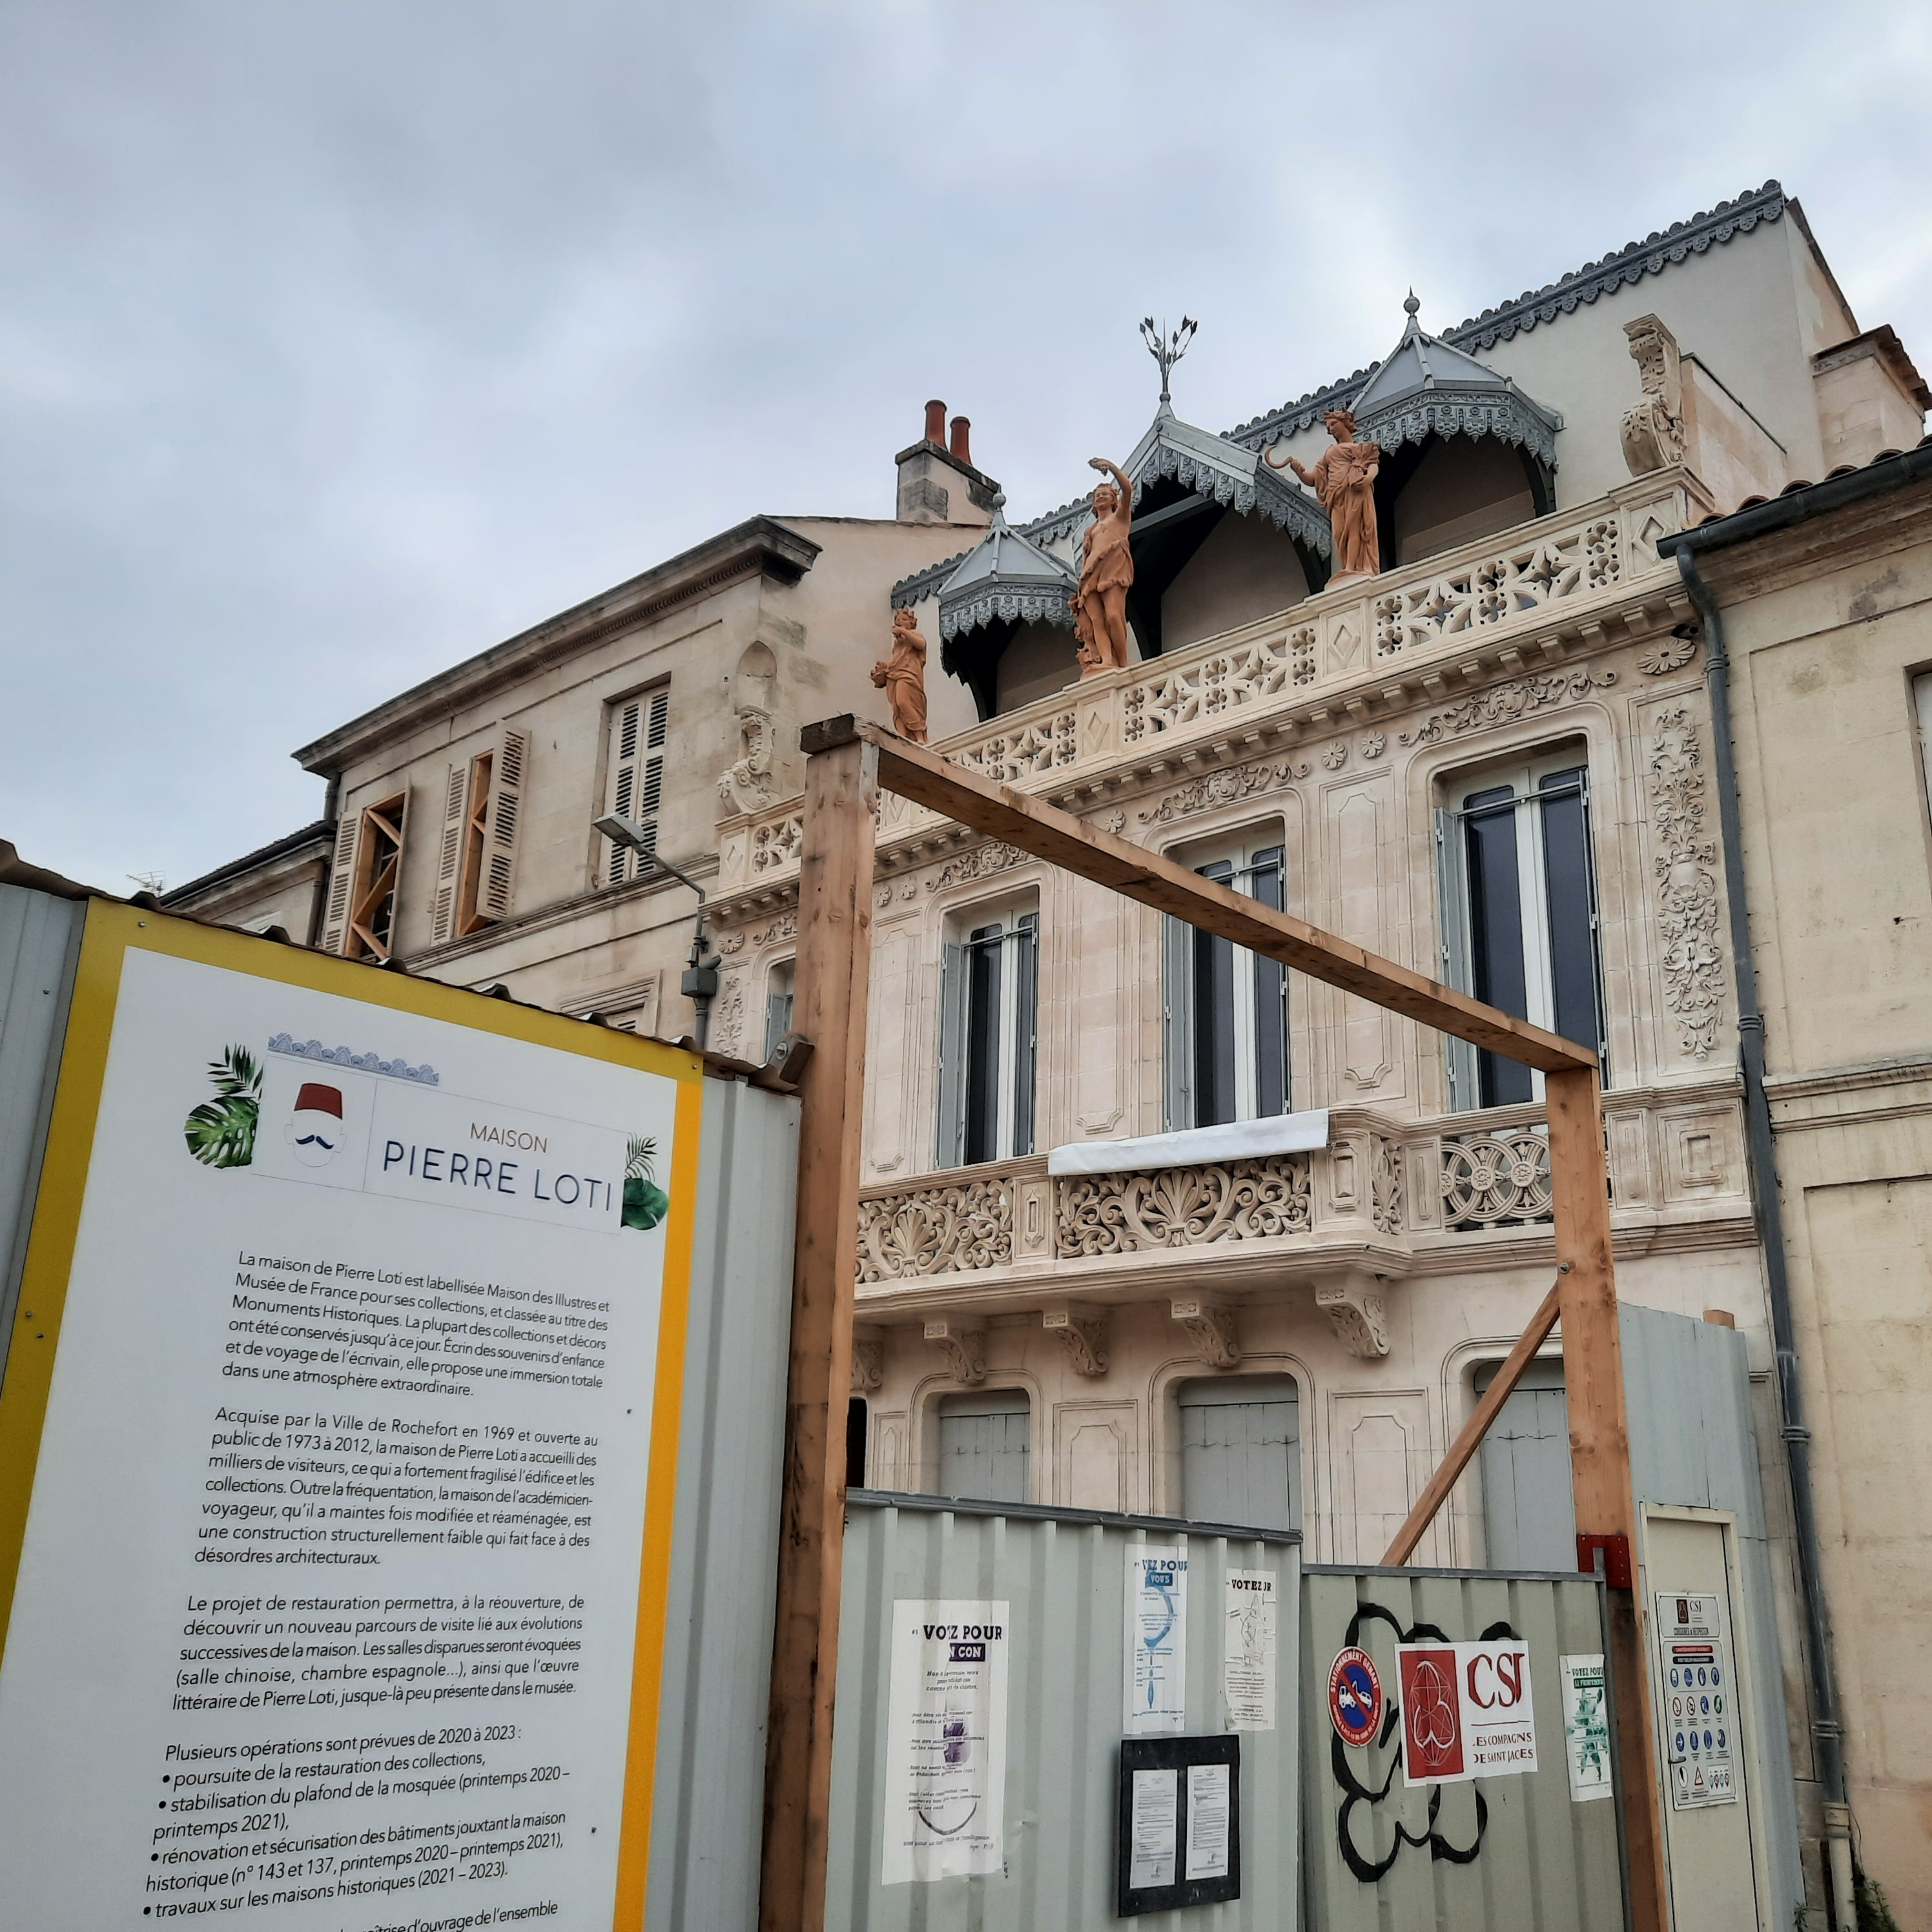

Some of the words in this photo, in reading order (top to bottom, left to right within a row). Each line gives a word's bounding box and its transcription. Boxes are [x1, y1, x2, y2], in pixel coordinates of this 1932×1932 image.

[470, 1122, 548, 1153] MAISON
[384, 1140, 519, 1194] PIERRE
[534, 1169, 611, 1211] LOTI
[239, 1250, 255, 1266] La
[259, 1256, 310, 1273] maison
[314, 1260, 332, 1276] de
[335, 1262, 375, 1281] Pierre
[378, 1268, 402, 1284] Loti
[405, 1275, 424, 1288] est
[427, 1273, 484, 1295] labellisée
[487, 1283, 529, 1301] Maison
[533, 1289, 553, 1304] des
[555, 1292, 597, 1310] Illustres
[598, 1301, 610, 1312] et
[236, 1271, 285, 1291] Musée
[289, 1278, 307, 1294] de
[311, 1280, 357, 1300] France
[360, 1291, 394, 1306] pour
[395, 1295, 415, 1307] ses
[418, 1295, 488, 1318] collections,
[490, 1306, 502, 1318] et
[504, 1305, 546, 1323] classée
[548, 1315, 562, 1325] au
[564, 1313, 586, 1328] titre
[588, 1316, 608, 1331] des
[232, 1293, 320, 1317] Monuments
[323, 1304, 402, 1328] Historiques.
[406, 1313, 421, 1328] La
[422, 1316, 468, 1336] plupart
[469, 1321, 491, 1337] des
[493, 1324, 555, 1344] collections
[557, 1334, 568, 1346] et
[570, 1333, 606, 1350] décors
[222, 1360, 258, 1378] dans
[262, 1368, 289, 1381] une
[293, 1370, 377, 1390] atmosphère
[380, 1378, 474, 1396] extraordinaire.
[225, 1341, 241, 1354] et
[243, 1339, 263, 1356] de
[266, 1346, 318, 1364] voyage
[321, 1347, 340, 1363] de
[406, 1355, 429, 1372] elle
[431, 1362, 483, 1379] propose
[485, 1367, 508, 1379] une
[509, 1366, 570, 1384] immersion
[571, 1374, 603, 1388] totale
[215, 1406, 279, 1428] Acquise
[284, 1415, 311, 1431] par
[314, 1412, 327, 1428] la
[333, 1414, 364, 1430] Ville
[368, 1416, 387, 1432] de
[391, 1418, 458, 1437] Rochefort
[462, 1427, 478, 1438] en
[484, 1424, 515, 1440] 1969
[518, 1430, 531, 1442] et
[535, 1432, 581, 1445] ouverte
[584, 1436, 598, 1446] au
[202, 1503, 277, 1520] voyageur,
[317, 1506, 325, 1518] a
[329, 1505, 385, 1520] maintes
[389, 1504, 412, 1521] fois
[415, 1506, 473, 1523] modifiée
[477, 1511, 490, 1523] et
[492, 1509, 571, 1529] réaménagée,
[574, 1514, 591, 1526] est
[198, 1527, 228, 1539] une
[232, 1526, 327, 1541] construction
[331, 1527, 444, 1543] structurellement
[447, 1528, 483, 1545] faible
[486, 1531, 506, 1549] qui
[509, 1530, 528, 1545] fait
[531, 1530, 556, 1546] face
[559, 1532, 566, 1546] à
[568, 1532, 590, 1547] des
[194, 1546, 272, 1563] désordres
[276, 1547, 381, 1565] architecturaux.
[1150, 1574, 1171, 1583] VOUS
[1231, 1579, 1262, 1591] VOTEZ
[188, 1594, 207, 1611] Le
[212, 1595, 262, 1616] projet
[266, 1594, 287, 1610] de
[291, 1595, 380, 1610] restauration
[384, 1596, 457, 1614] permettra,
[462, 1594, 469, 1609] à
[474, 1594, 484, 1609] la
[489, 1594, 564, 1610] réouverture,
[568, 1594, 584, 1608] de
[183, 1618, 262, 1636] découvrir
[264, 1622, 283, 1634] un
[287, 1621, 352, 1634] nouveau
[355, 1621, 416, 1638] parcours
[420, 1616, 437, 1632] de
[440, 1617, 475, 1631] visite
[478, 1616, 493, 1631] lié
[495, 1619, 517, 1630] aux
[520, 1614, 582, 1630] évolutions
[963, 1625, 1002, 1640] POUR
[958, 1646, 982, 1658] CON
[176, 1667, 219, 1688] (salle
[225, 1666, 296, 1684] chinoise,
[301, 1663, 367, 1681] chambre
[471, 1660, 500, 1675] ainsi
[504, 1662, 529, 1678] que
[165, 1743, 237, 1762] Plusieurs
[240, 1738, 323, 1762] opérations
[325, 1736, 357, 1752] sont
[359, 1732, 415, 1755] prévues
[418, 1729, 435, 1745] de
[438, 1727, 471, 1744] 2020
[473, 1727, 481, 1742] à
[1487, 1751, 1506, 1763] SAINT
[174, 1766, 251, 1793] poursuite
[254, 1763, 275, 1781] de
[279, 1762, 291, 1779] la
[295, 1757, 381, 1778] restauration
[384, 1754, 409, 1771] des
[412, 1751, 486, 1769] collections,
[152, 1820, 238, 1845] printemps
[241, 1812, 289, 1832] 2021),
[155, 1899, 216, 1918] travaux
[220, 1896, 245, 1910] sur
[247, 1889, 269, 1907] les
[272, 1885, 334, 1904] maisons
[337, 1875, 415, 1896] historiques
[418, 1866, 455, 1889] (2021
[468, 1860, 508, 1880] 2023).
[475, 1909, 491, 1926] de
